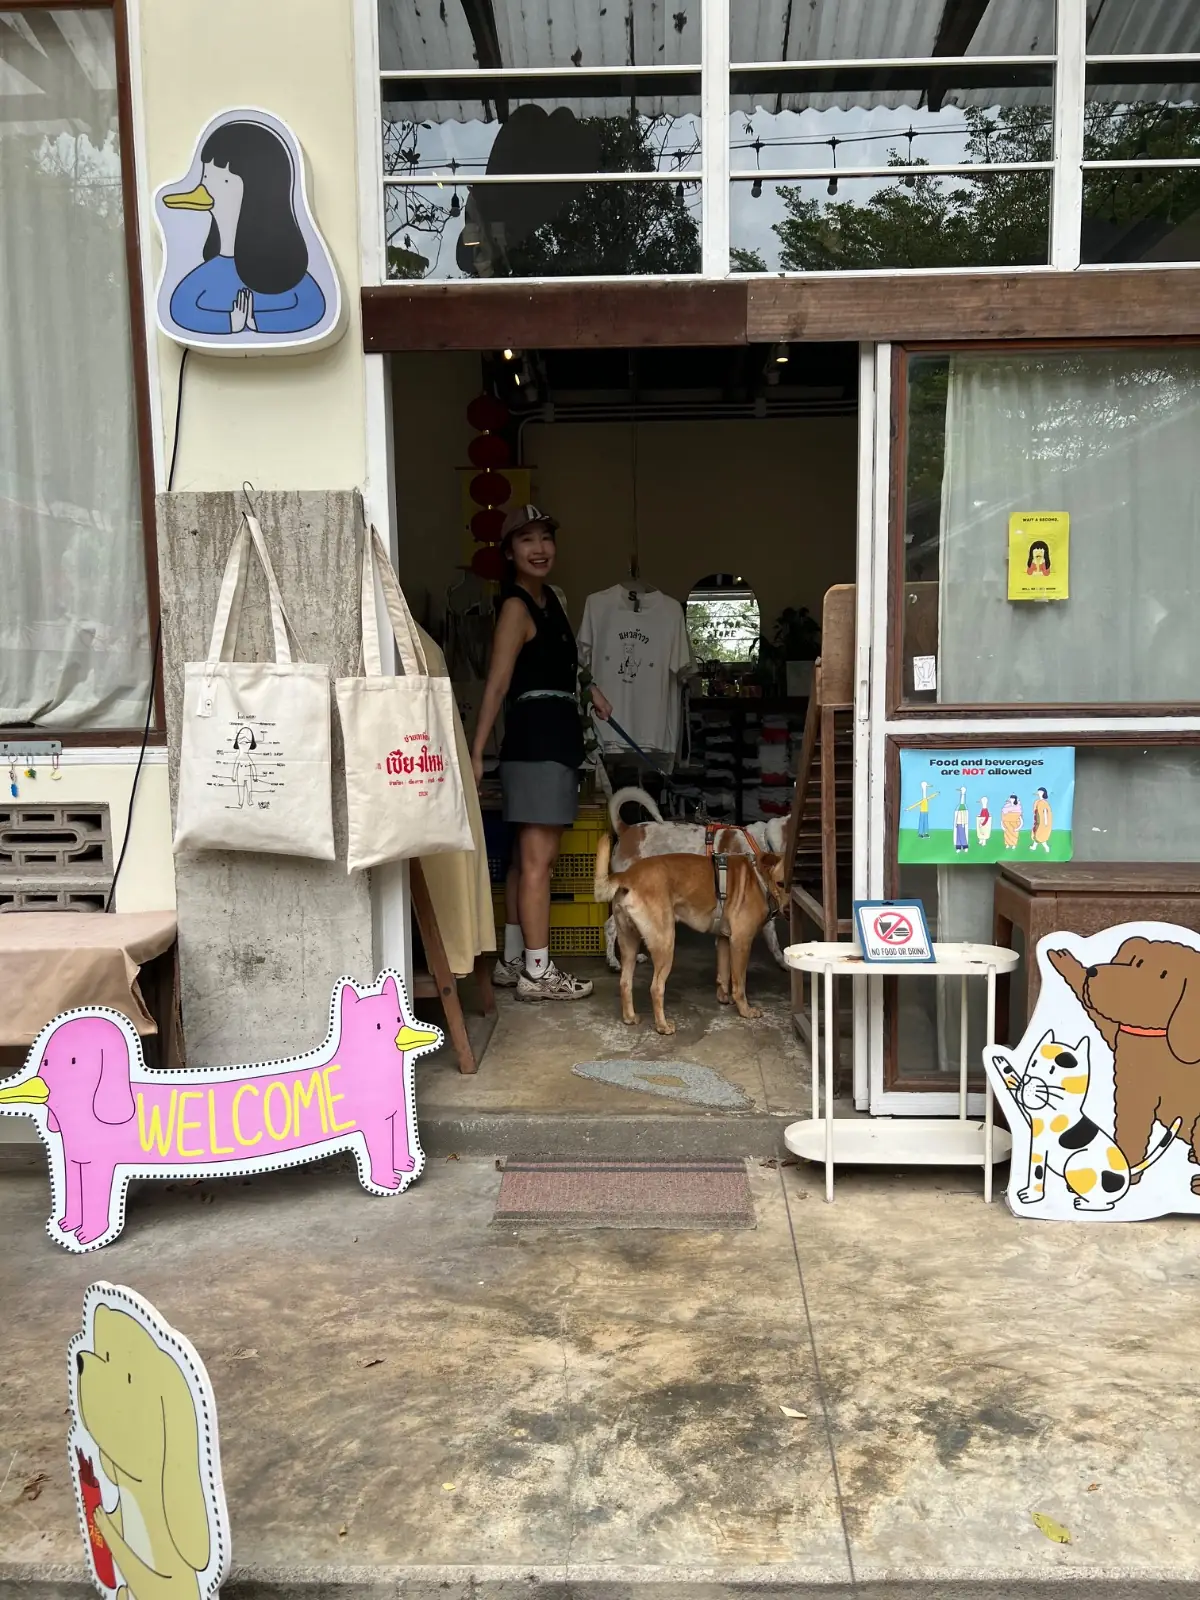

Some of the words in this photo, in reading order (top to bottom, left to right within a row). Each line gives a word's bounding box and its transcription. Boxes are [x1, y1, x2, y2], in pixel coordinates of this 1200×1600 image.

[706, 629, 736, 638] STORE
[929, 758, 959, 766] Food
[960, 758, 983, 766] and
[984, 758, 1044, 768] beverages
[988, 768, 1032, 776] allowed
[908, 948, 926, 956] DRINK
[136, 1064, 357, 1157] WELCOME
